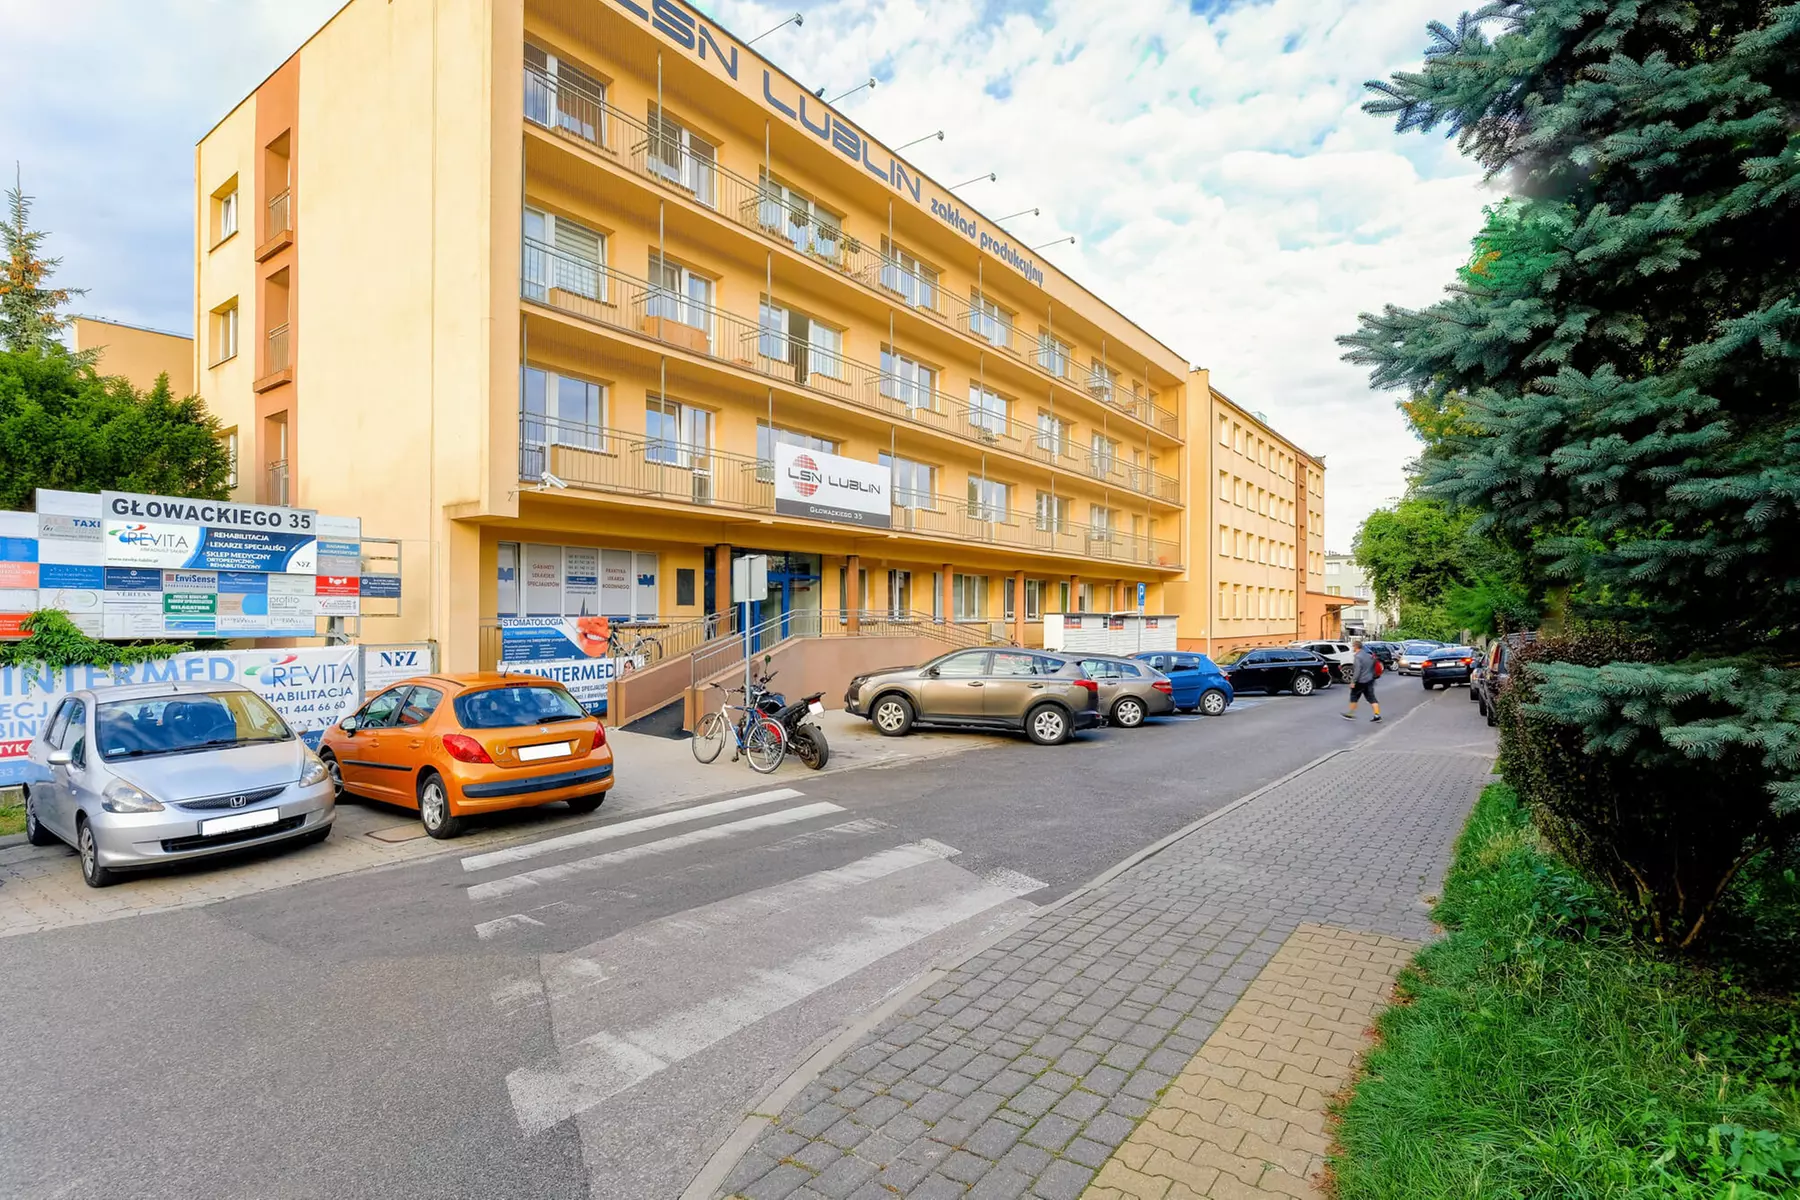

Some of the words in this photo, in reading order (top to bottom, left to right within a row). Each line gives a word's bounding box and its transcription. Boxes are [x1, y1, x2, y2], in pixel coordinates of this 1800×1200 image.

[763, 69, 921, 204] LUBLIN
[930, 197, 977, 240] zakład
[980, 233, 1044, 288] produkcyjny
[788, 467, 822, 484] LSN
[828, 475, 881, 495] LUBLIN
[111, 498, 282, 527] GŁOWACKIEGO
[289, 513, 311, 529] 35
[73, 519, 101, 528] TAXI
[127, 531, 188, 548] REVITA
[213, 531, 270, 542] REHABILITACJA
[209, 541, 243, 550] LEKARZE
[244, 543, 286, 552] SPECJALIŚCI
[230, 553, 271, 561] MEDYCZNY
[175, 574, 216, 584] EnviSense
[503, 618, 564, 627] STOMATOLOGIA
[380, 651, 418, 668] NFZ
[272, 663, 355, 688] REVITA
[263, 687, 353, 703] HABILITACJA
[294, 704, 314, 714] 444
[318, 702, 331, 712] 66
[334, 700, 346, 709] 60
